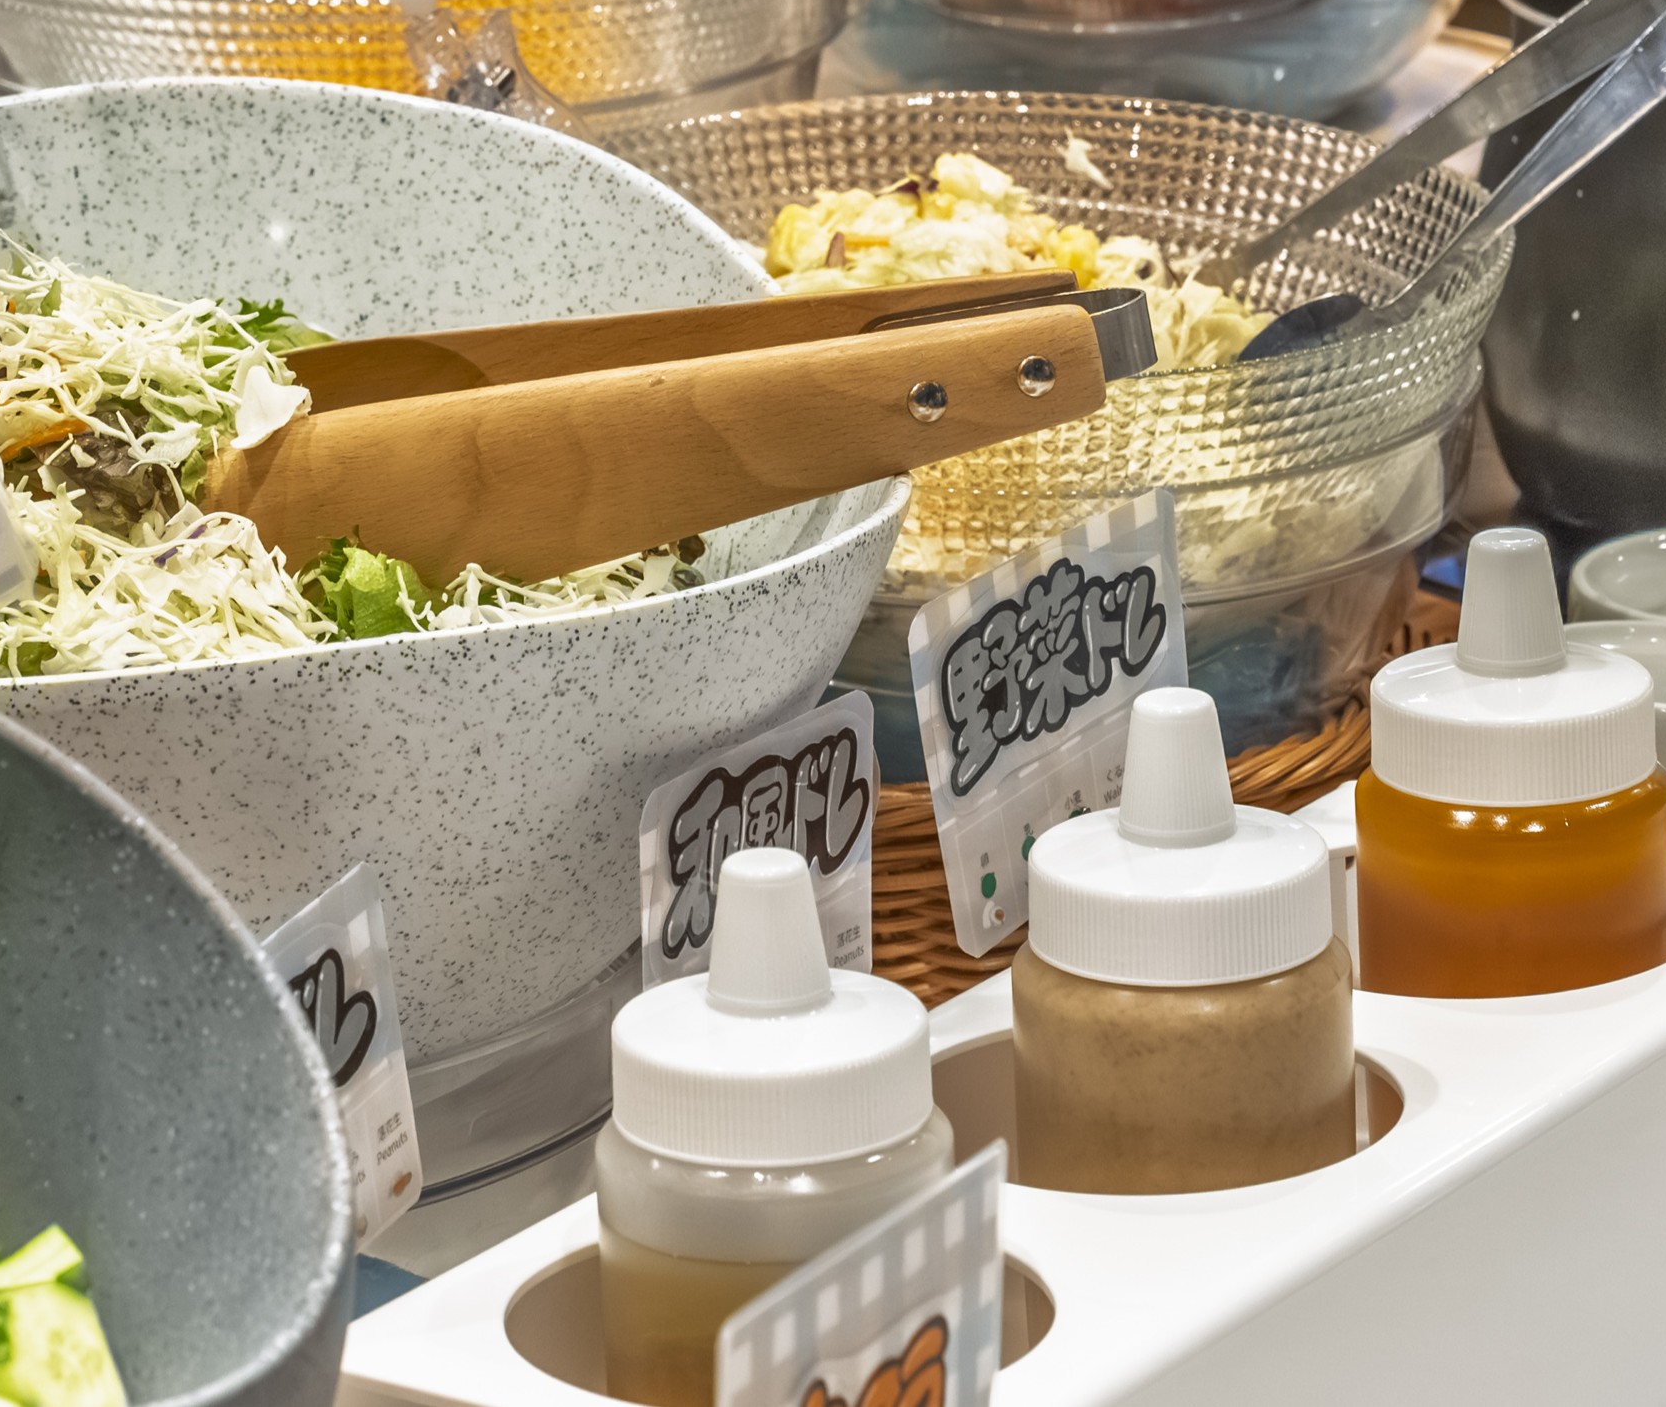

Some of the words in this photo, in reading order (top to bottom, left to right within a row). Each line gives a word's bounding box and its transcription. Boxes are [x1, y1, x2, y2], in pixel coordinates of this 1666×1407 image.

[941, 557, 1167, 797] 野菜ドレ
[662, 726, 870, 960] 和風ドレ
